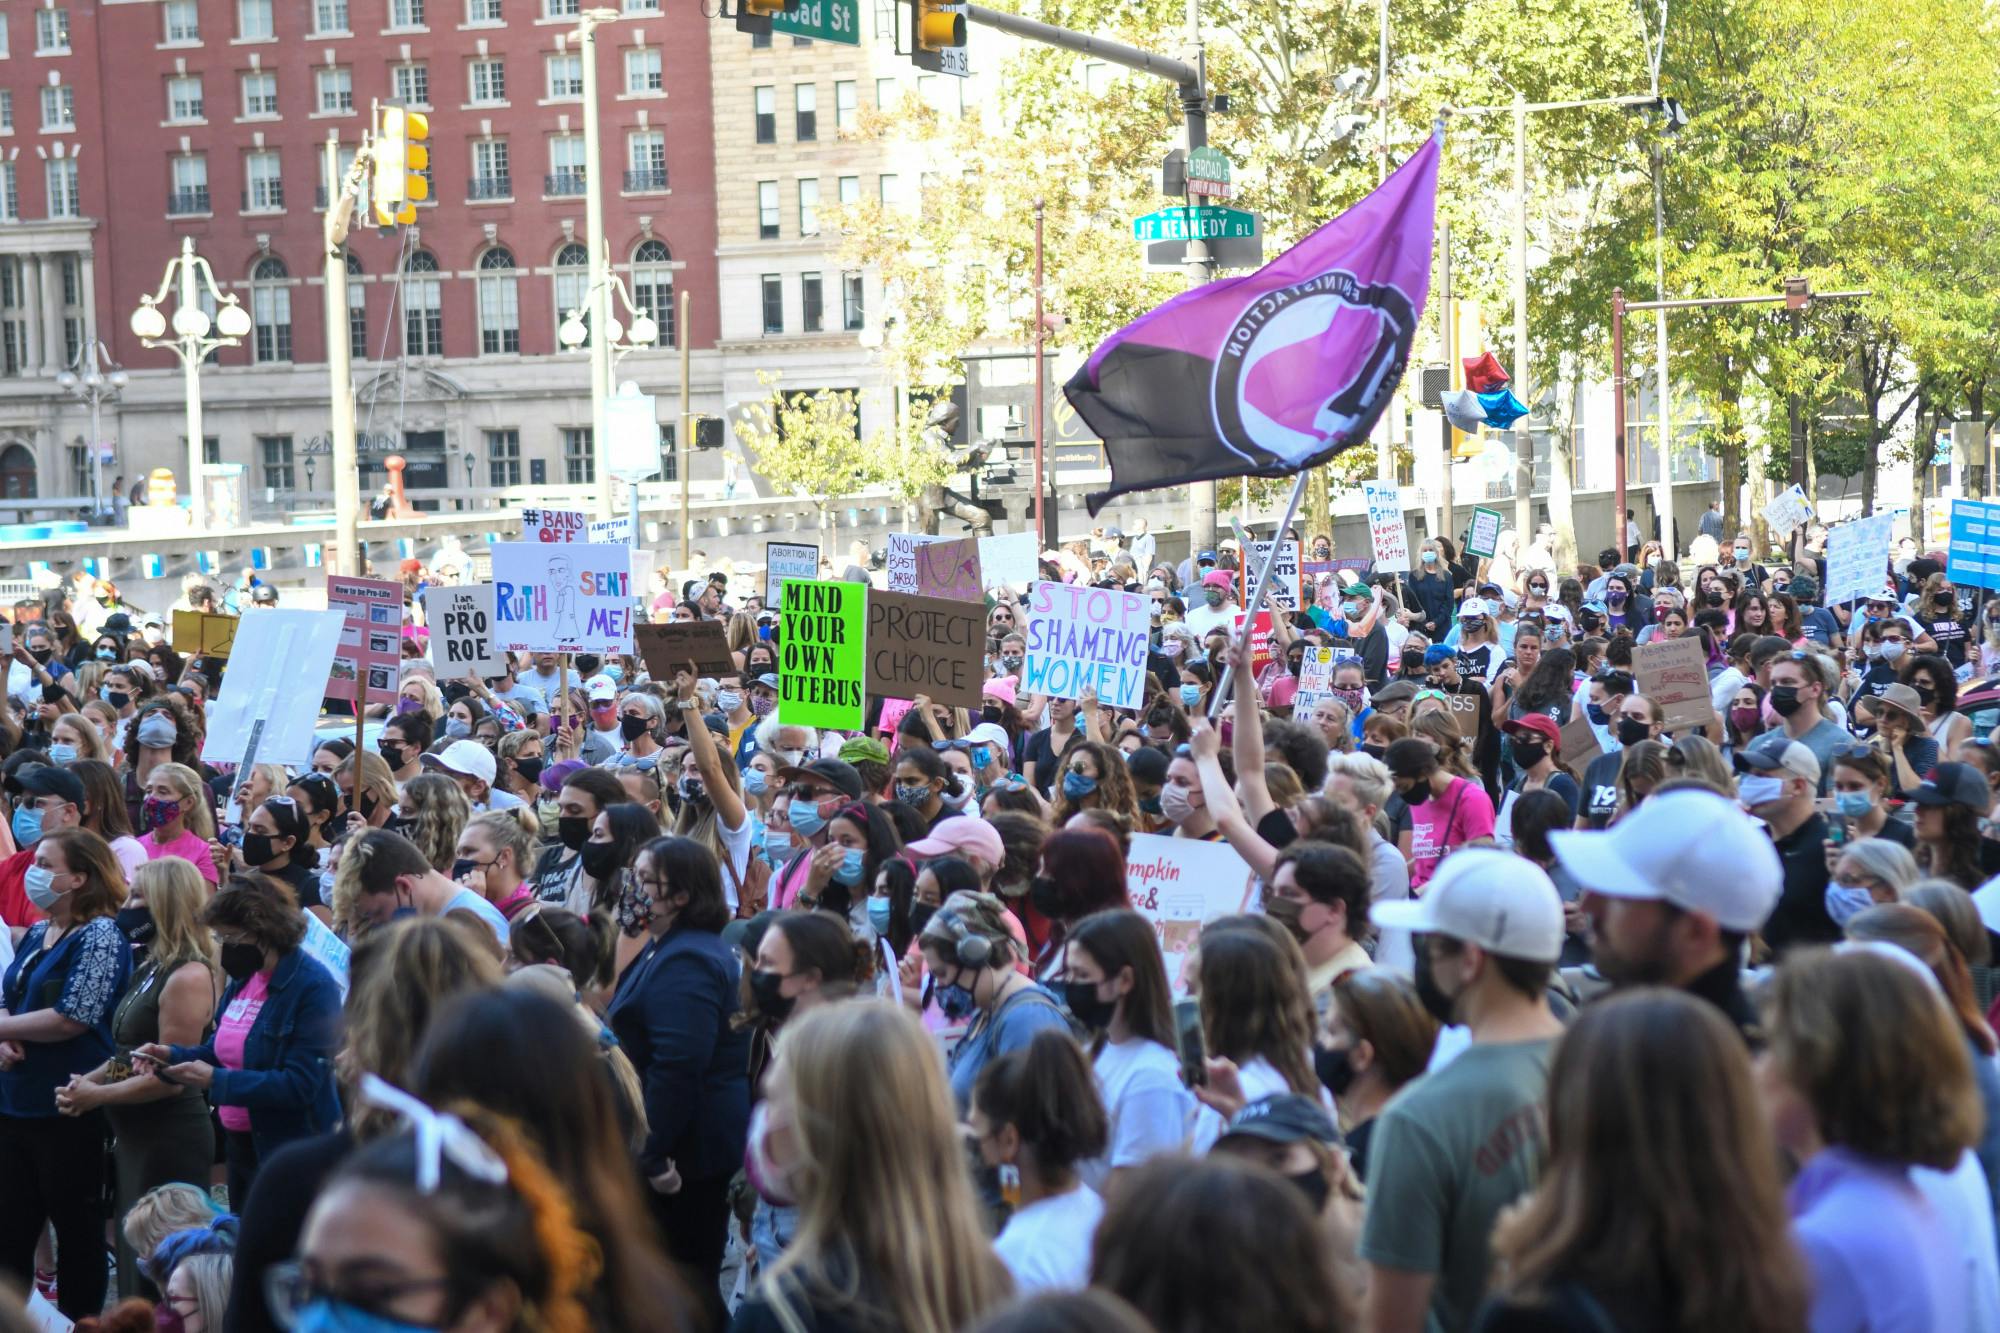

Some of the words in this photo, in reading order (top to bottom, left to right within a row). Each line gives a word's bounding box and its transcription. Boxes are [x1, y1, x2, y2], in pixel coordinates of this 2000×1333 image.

[831, 3, 851, 33] St
[959, 53, 969, 72] St
[1195, 158, 1222, 179] BROAD
[1137, 221, 1155, 240] JF
[1161, 218, 1228, 239] KENNEDY
[1236, 223, 1251, 236] BL
[771, 547, 807, 559] ABORTION
[808, 551, 816, 561] IS
[579, 570, 628, 597] SENT
[786, 583, 843, 614] MIND
[1033, 582, 1143, 630] STOP
[443, 610, 488, 636] PRO
[586, 606, 630, 638] ME!
[784, 613, 846, 645] YOUR
[869, 602, 979, 648] PROTECT
[446, 637, 492, 662] ROE
[1027, 618, 1148, 667] SHAMING
[1305, 647, 1317, 663] AS
[784, 642, 836, 675] OWN
[874, 649, 967, 690] CHOICE
[782, 673, 862, 708] UTERUS
[1027, 654, 1140, 706] WOMEN
[1299, 676, 1321, 691] HAVE
[1592, 784, 1617, 806] 19
